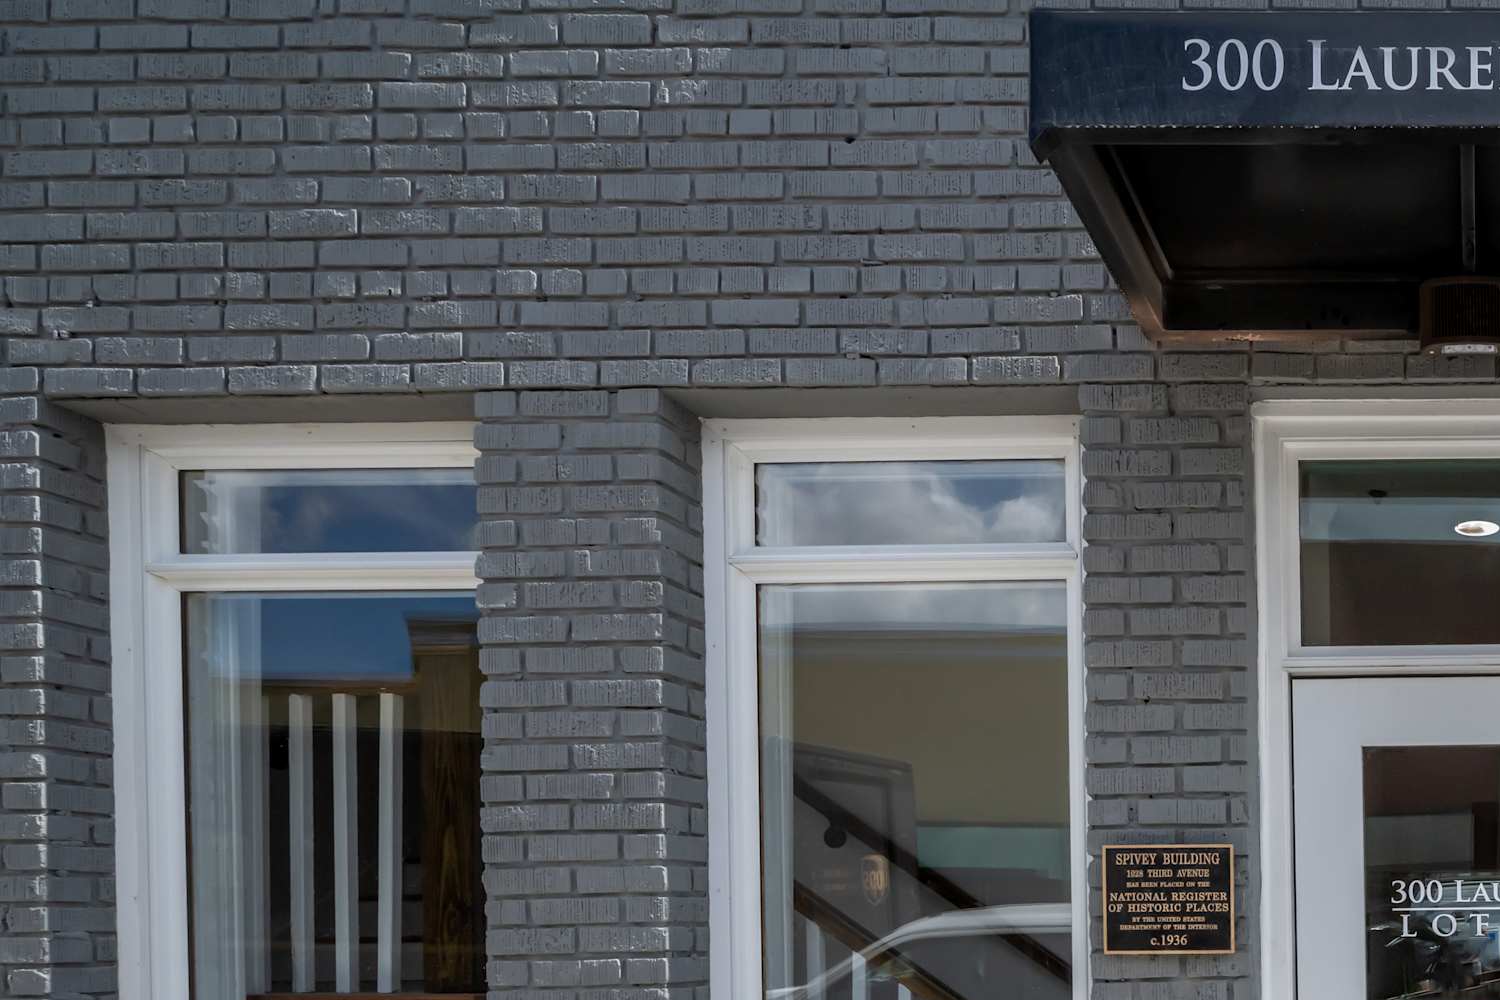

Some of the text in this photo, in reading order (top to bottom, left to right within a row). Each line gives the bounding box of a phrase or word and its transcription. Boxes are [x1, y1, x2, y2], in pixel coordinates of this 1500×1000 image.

[1181, 38, 1285, 92] 300
[1115, 853, 1220, 865] SPIVEY BUILDING
[1147, 869, 1173, 878] THIRD
[1177, 869, 1210, 878] AVENUE
[1110, 891, 1228, 901] NATIONAL REGISTER
[1391, 880, 1443, 904] 300
[1108, 903, 1229, 913] OF HISTORIC PLACES
[1150, 934, 1188, 946] c.1936
